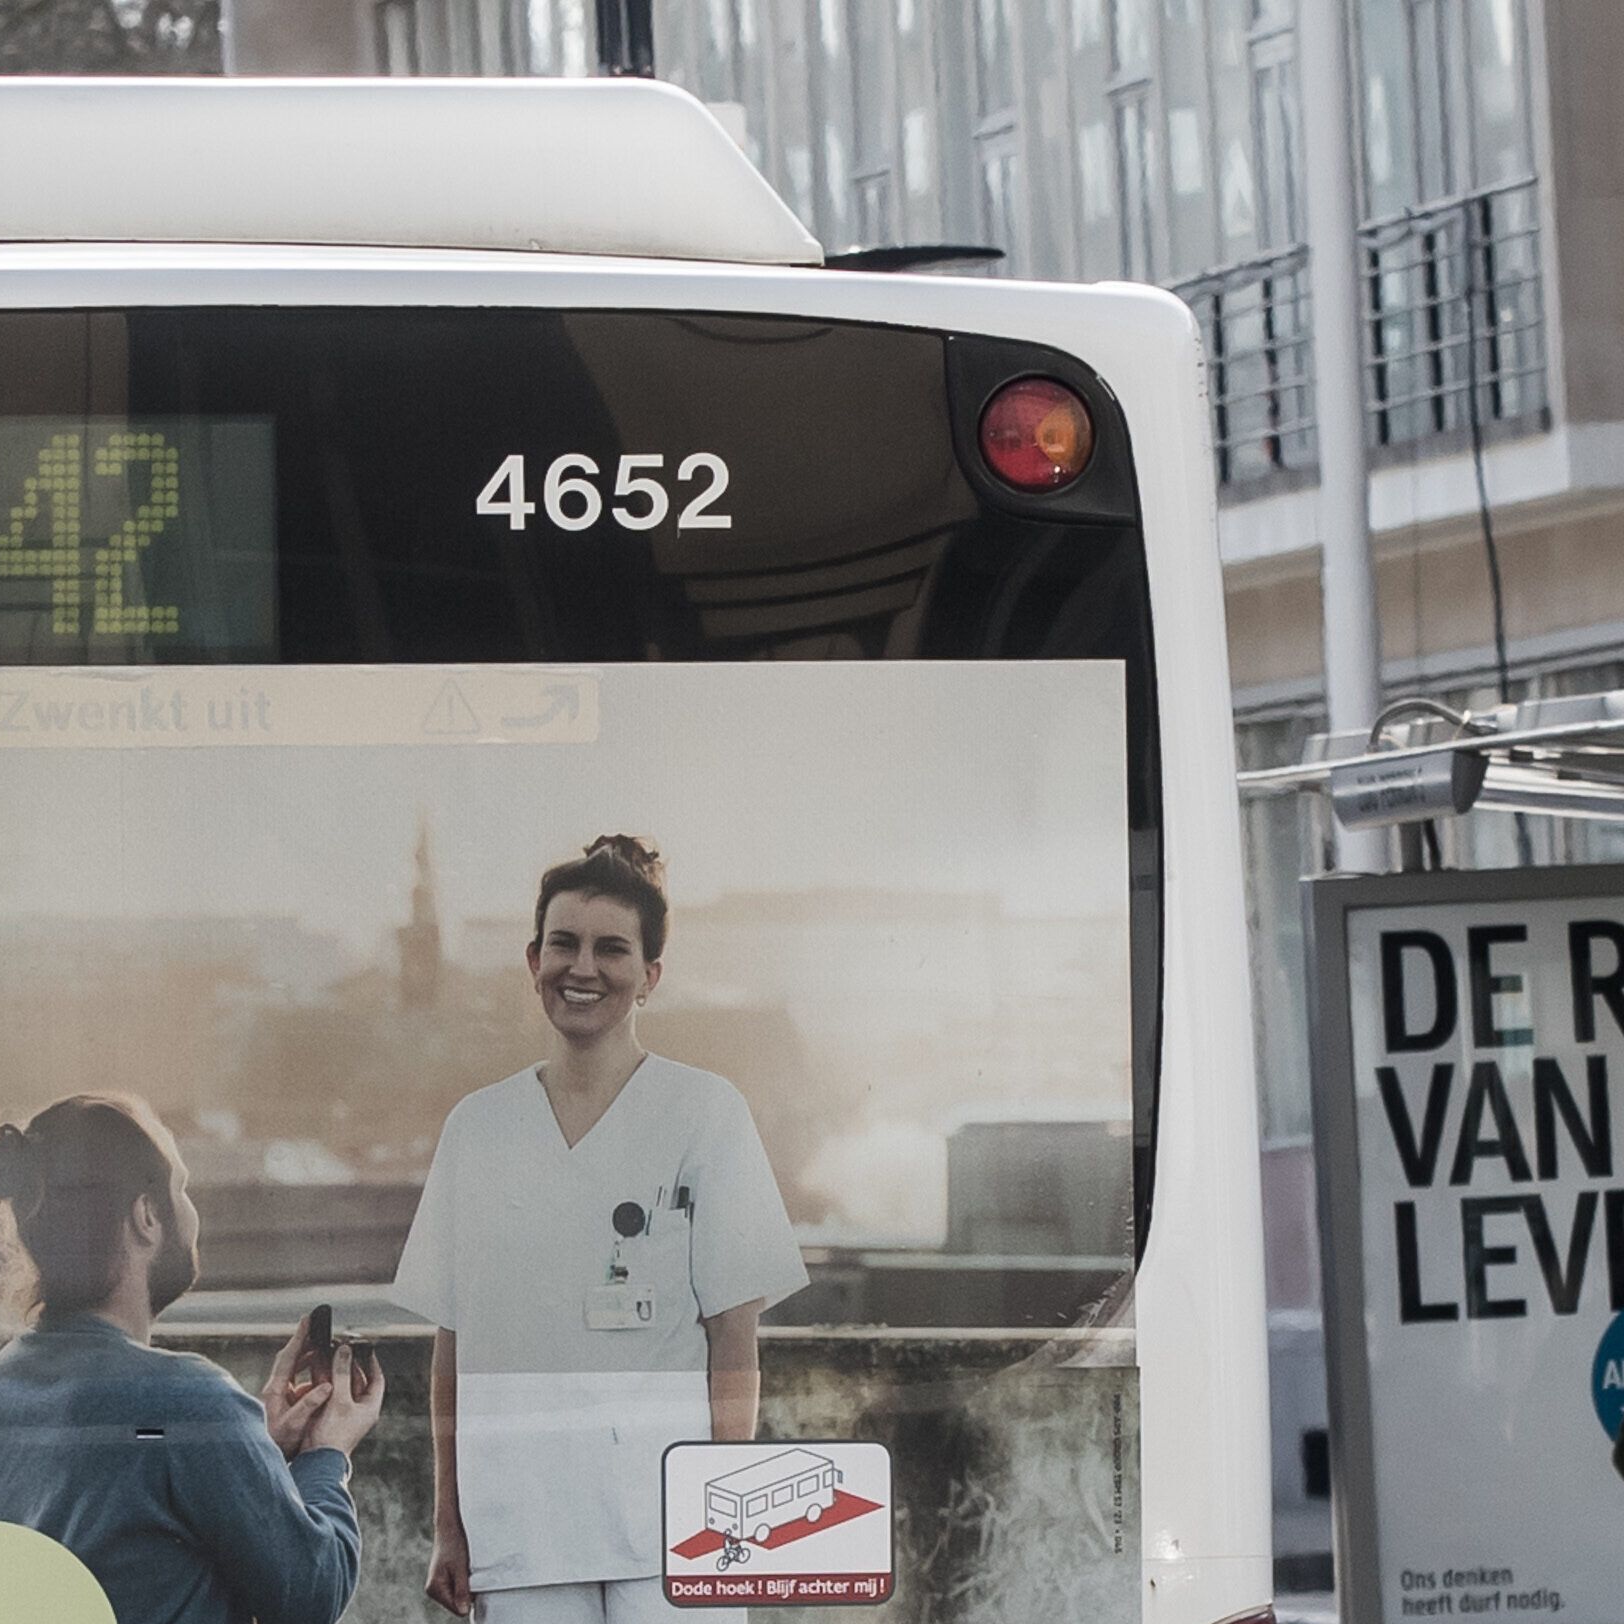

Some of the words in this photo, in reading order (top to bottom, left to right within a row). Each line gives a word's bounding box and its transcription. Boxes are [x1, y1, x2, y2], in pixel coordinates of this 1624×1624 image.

[476, 453, 732, 531] 4652
[207, 686, 272, 732] uit
[1379, 923, 1533, 1054] DE
[1375, 1053, 1614, 1188] VAN
[671, 1581, 713, 1597] Dode
[766, 1579, 795, 1600] Blijf
[798, 1579, 850, 1596] achter
[1400, 1567, 1437, 1592] Ons
[1442, 1566, 1514, 1589] denken
[1401, 1593, 1453, 1617] heeft
[1458, 1590, 1501, 1614] durf
